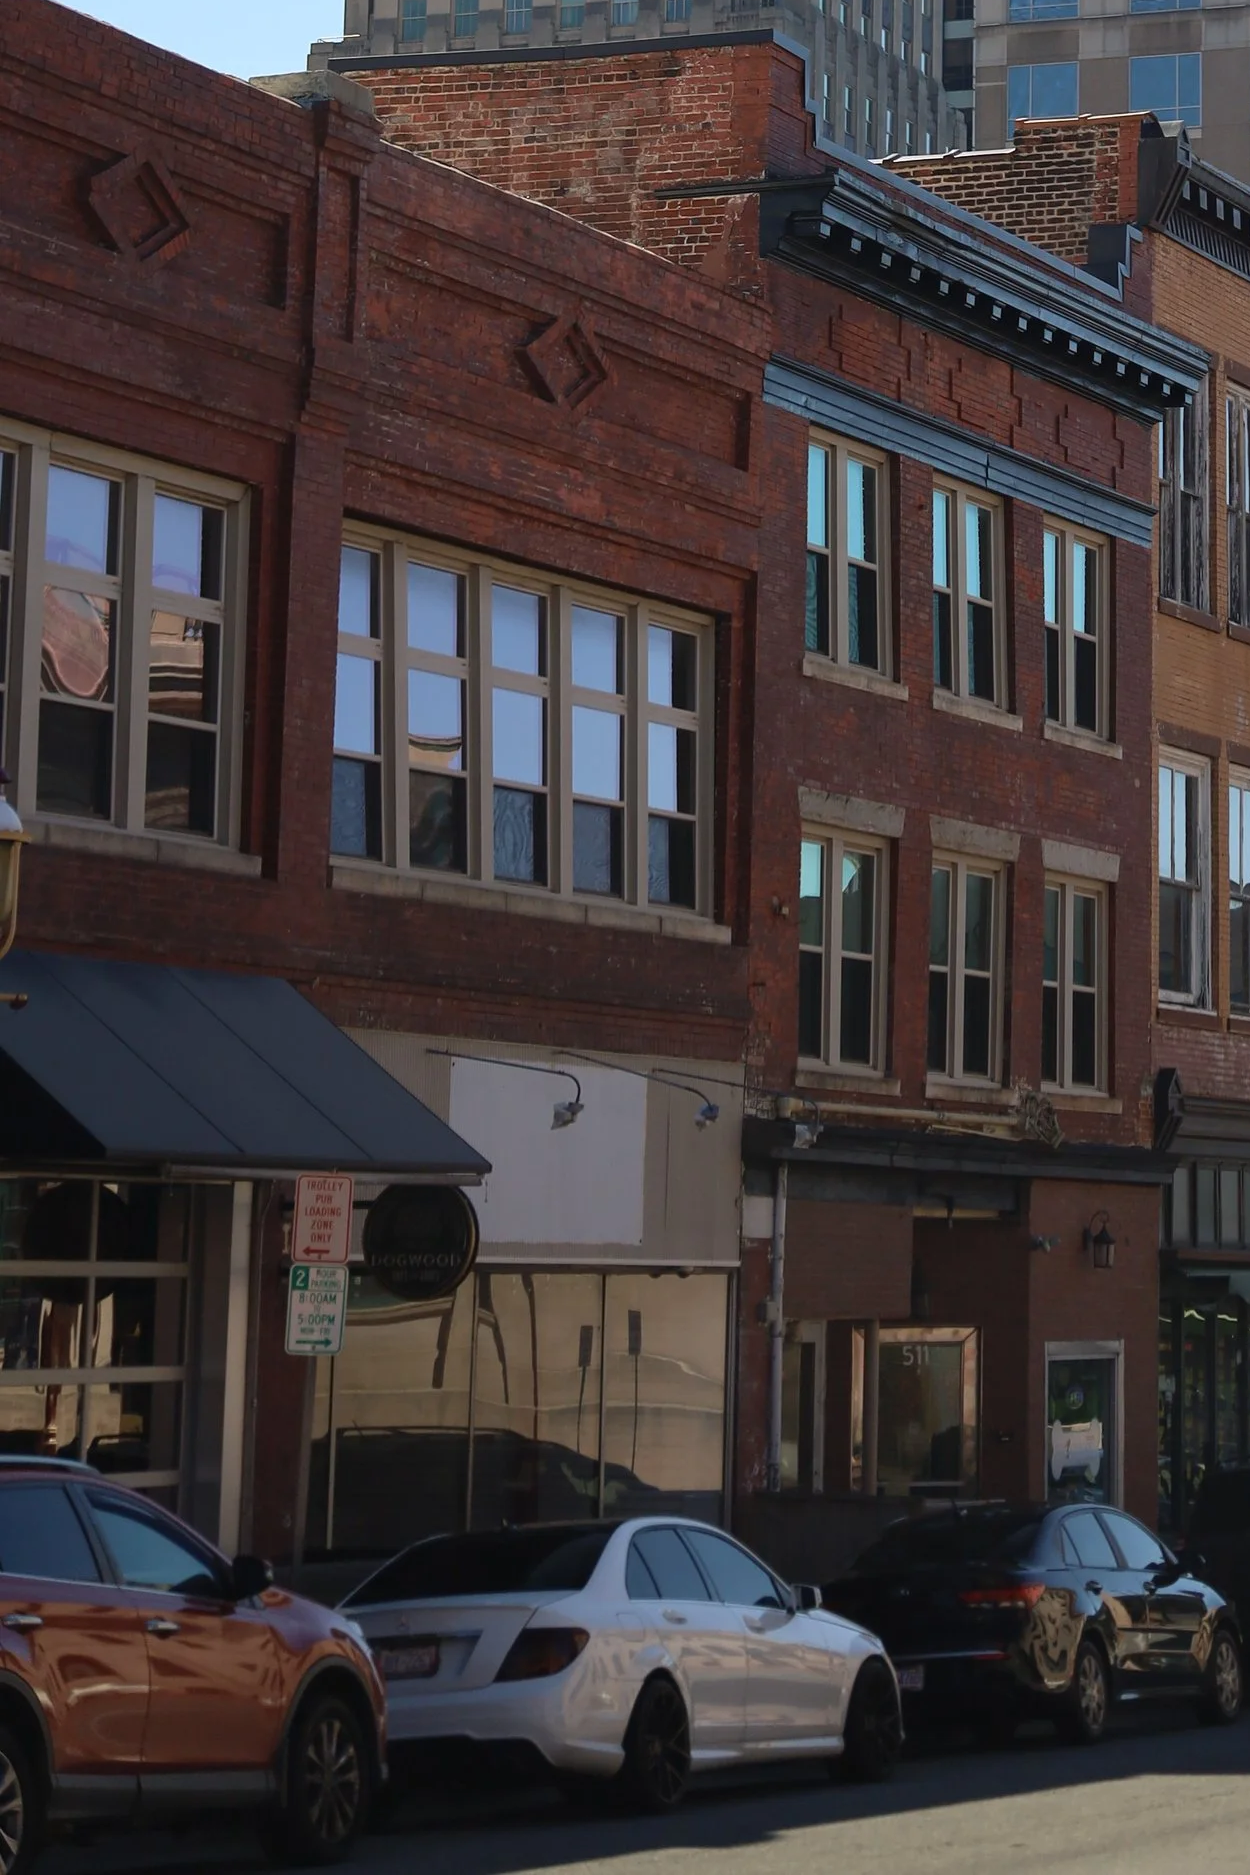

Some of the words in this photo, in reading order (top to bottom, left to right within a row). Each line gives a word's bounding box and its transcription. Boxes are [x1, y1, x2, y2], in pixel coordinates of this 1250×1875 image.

[307, 1180, 344, 1192] TROLLEY
[315, 1194, 333, 1205] PUB
[304, 1206, 342, 1217] LOADING
[310, 1220, 333, 1231] ZONE
[310, 1233, 332, 1243] ONLY
[371, 1251, 461, 1268] DOGWOOD
[295, 1270, 306, 1287] 2
[299, 1293, 337, 1305] 8:00AM
[298, 1314, 336, 1326] 5:00PM
[902, 1345, 930, 1367] 511
